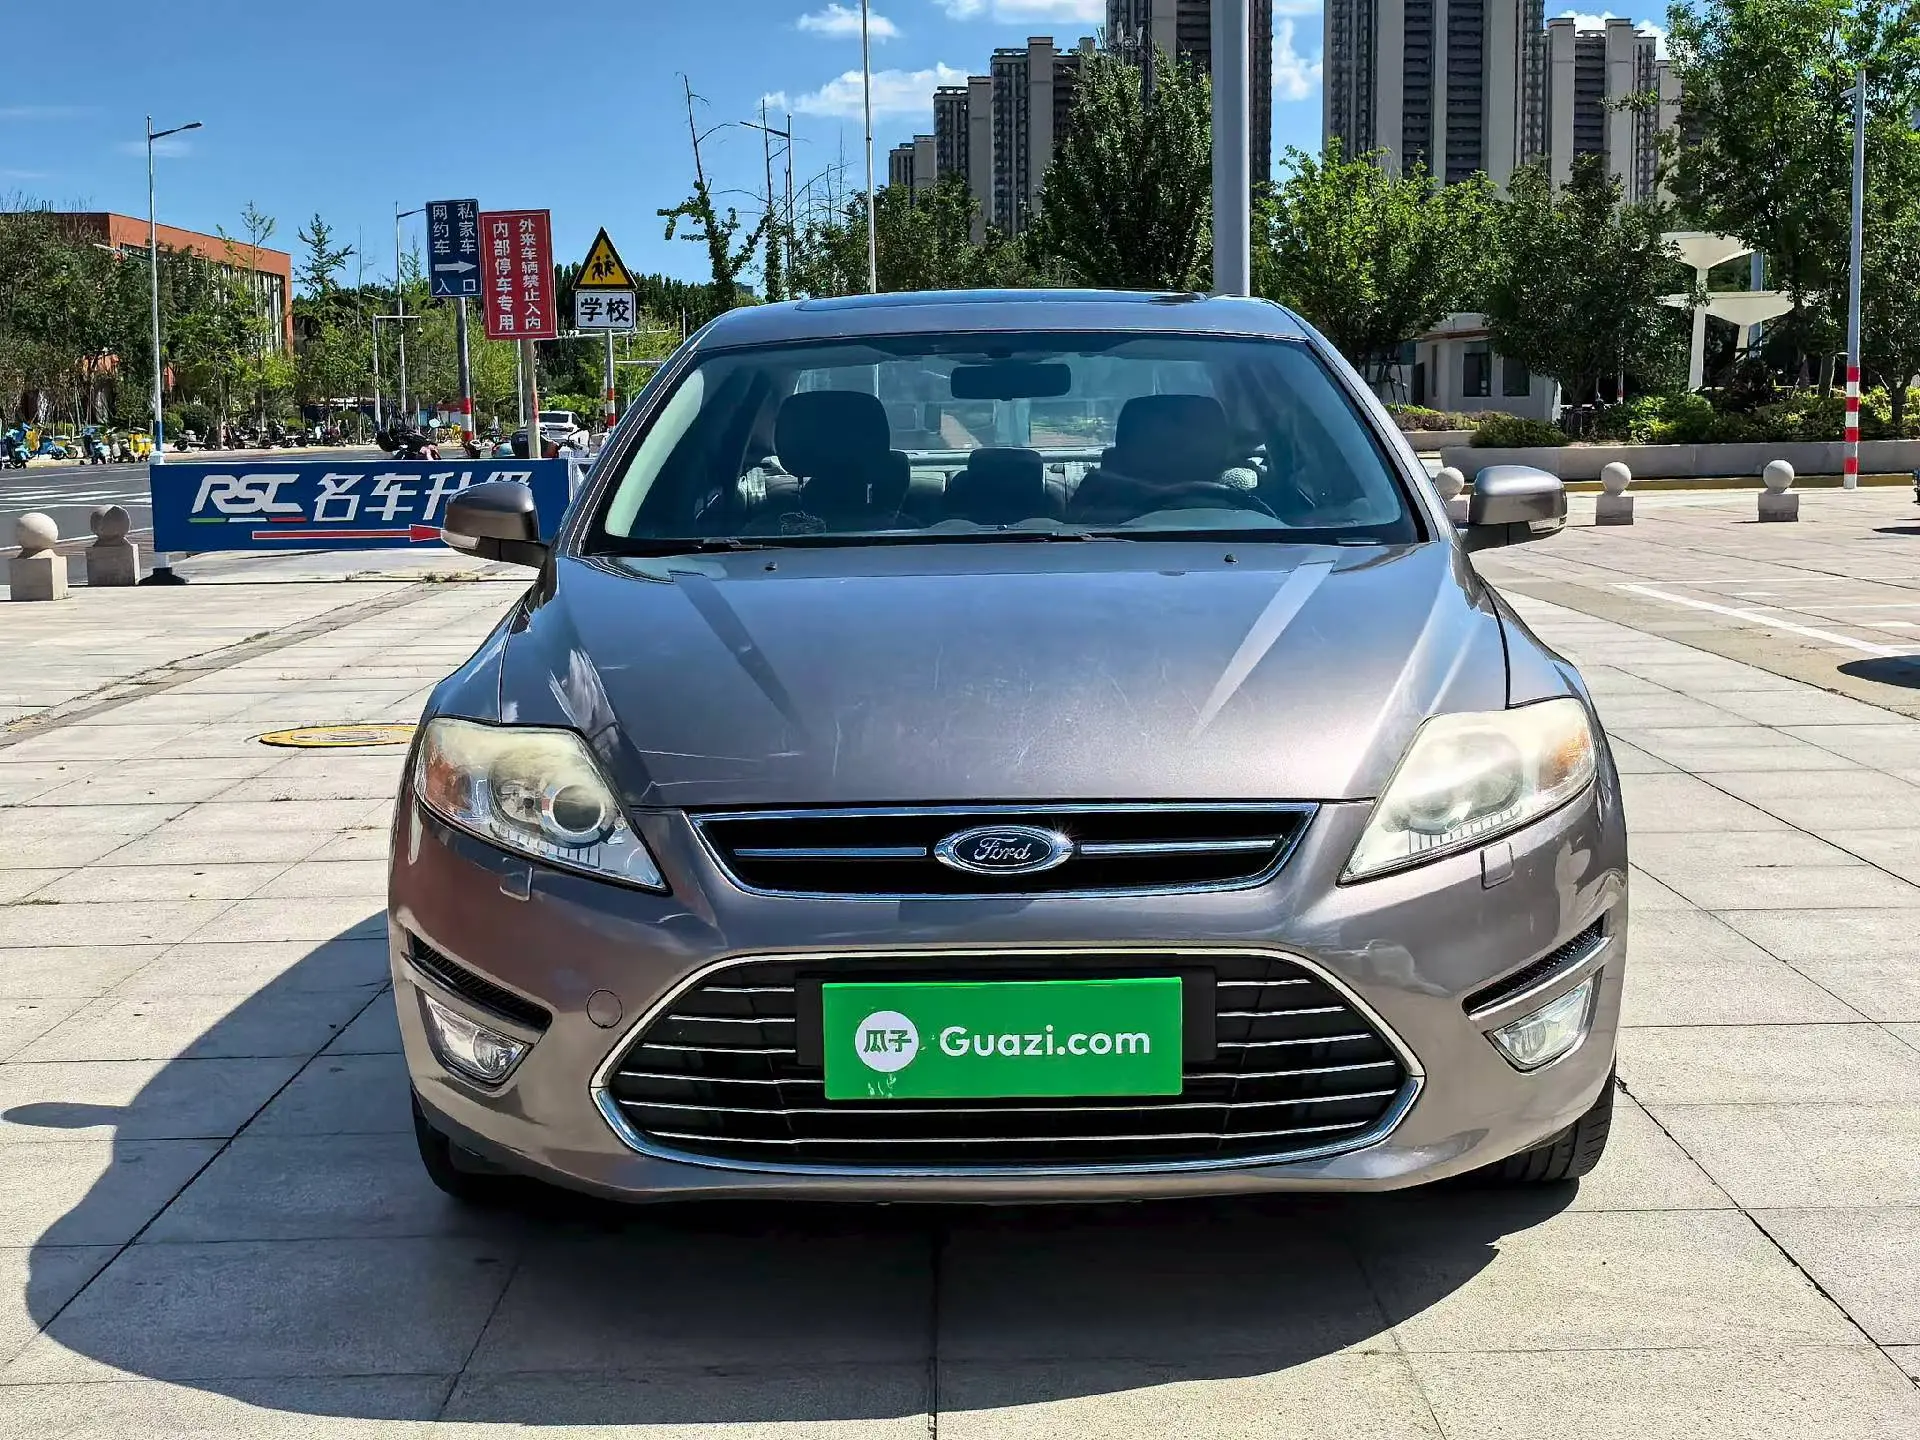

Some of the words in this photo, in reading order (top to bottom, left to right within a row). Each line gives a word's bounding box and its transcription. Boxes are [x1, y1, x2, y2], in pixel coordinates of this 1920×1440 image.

[433, 204, 450, 255] 网约车
[457, 203, 476, 254] 私家车
[436, 278, 476, 294] 入口
[492, 220, 514, 331] 内部停车专用
[519, 218, 541, 330] 外来车辆禁止入内
[580, 297, 630, 322] 学校
[191, 473, 304, 514] RSC
[313, 471, 532, 522] 名车升
[973, 837, 1031, 861] Ford
[863, 1029, 912, 1053] 瓜子
[940, 1025, 1151, 1057] Guazi.com
